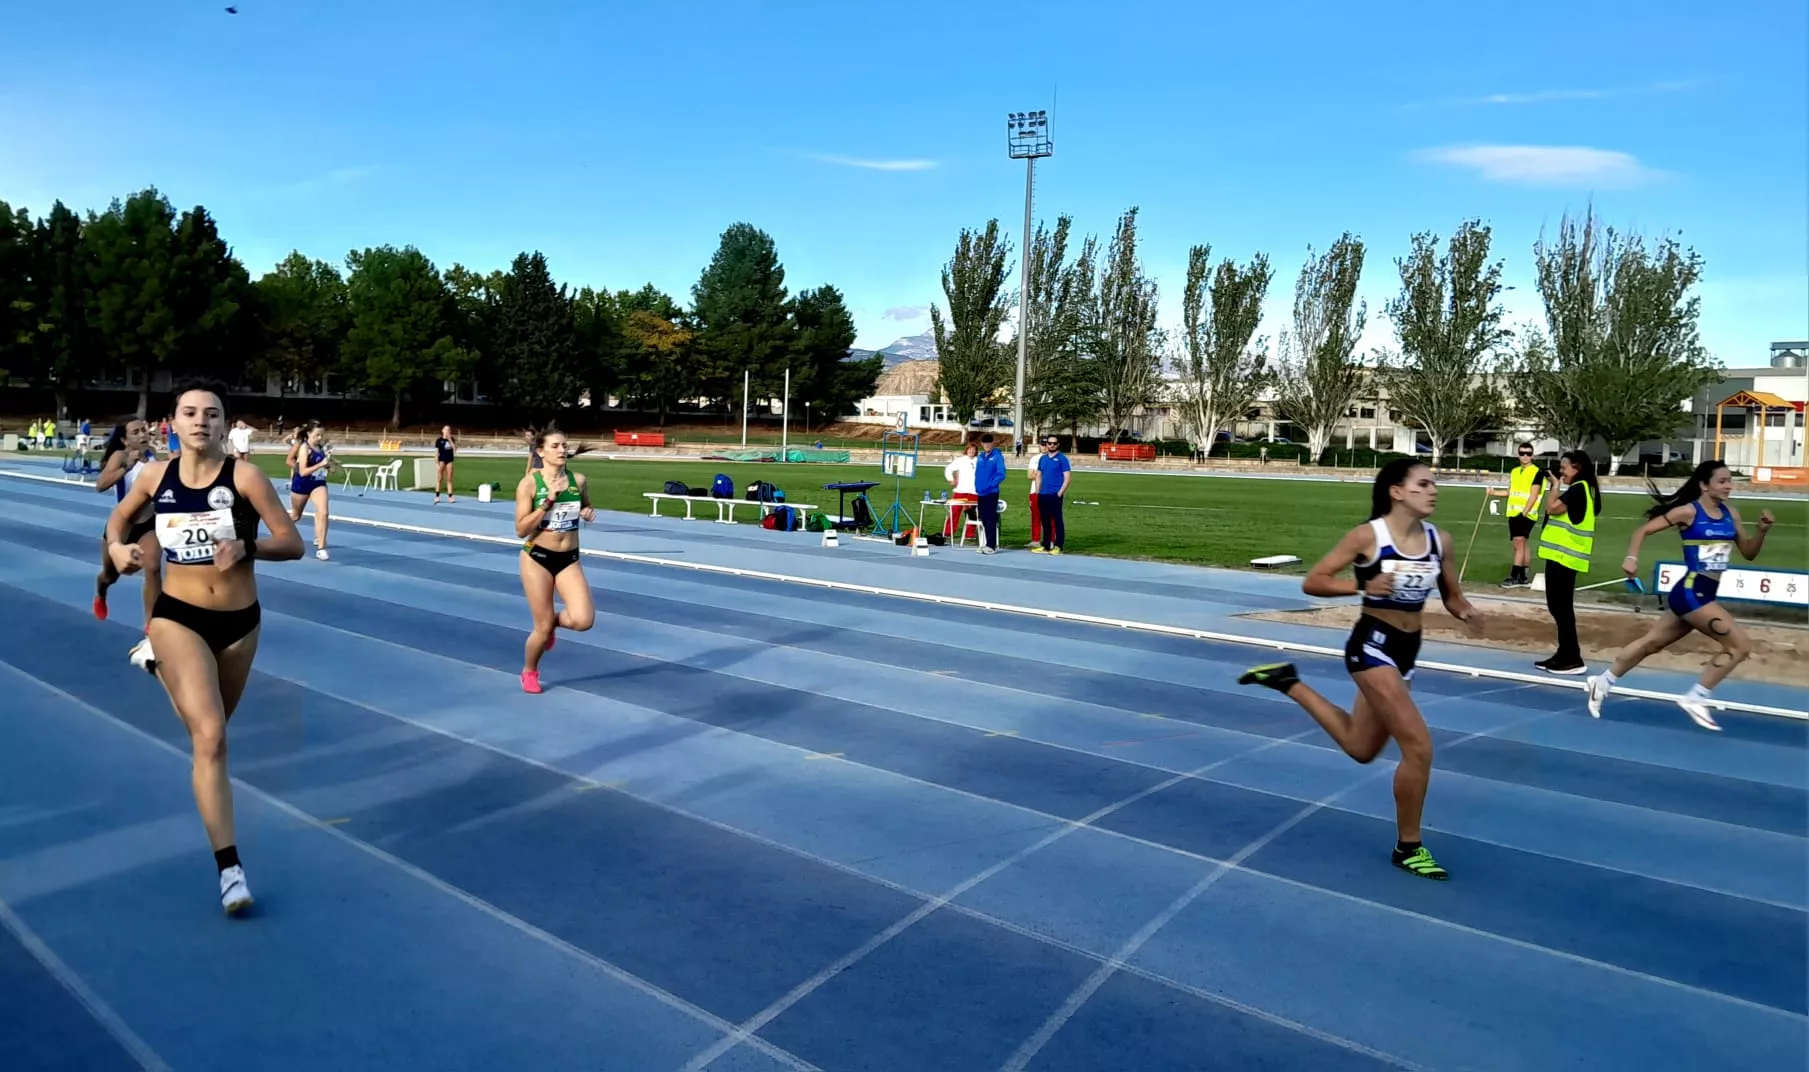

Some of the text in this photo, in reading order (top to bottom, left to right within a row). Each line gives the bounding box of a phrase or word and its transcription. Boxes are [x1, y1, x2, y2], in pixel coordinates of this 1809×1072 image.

[555, 511, 568, 520] 17
[182, 528, 209, 545] 20
[1403, 574, 1424, 588] 22
[1660, 570, 1671, 585] 5
[1736, 578, 1797, 593] 75 6 25
